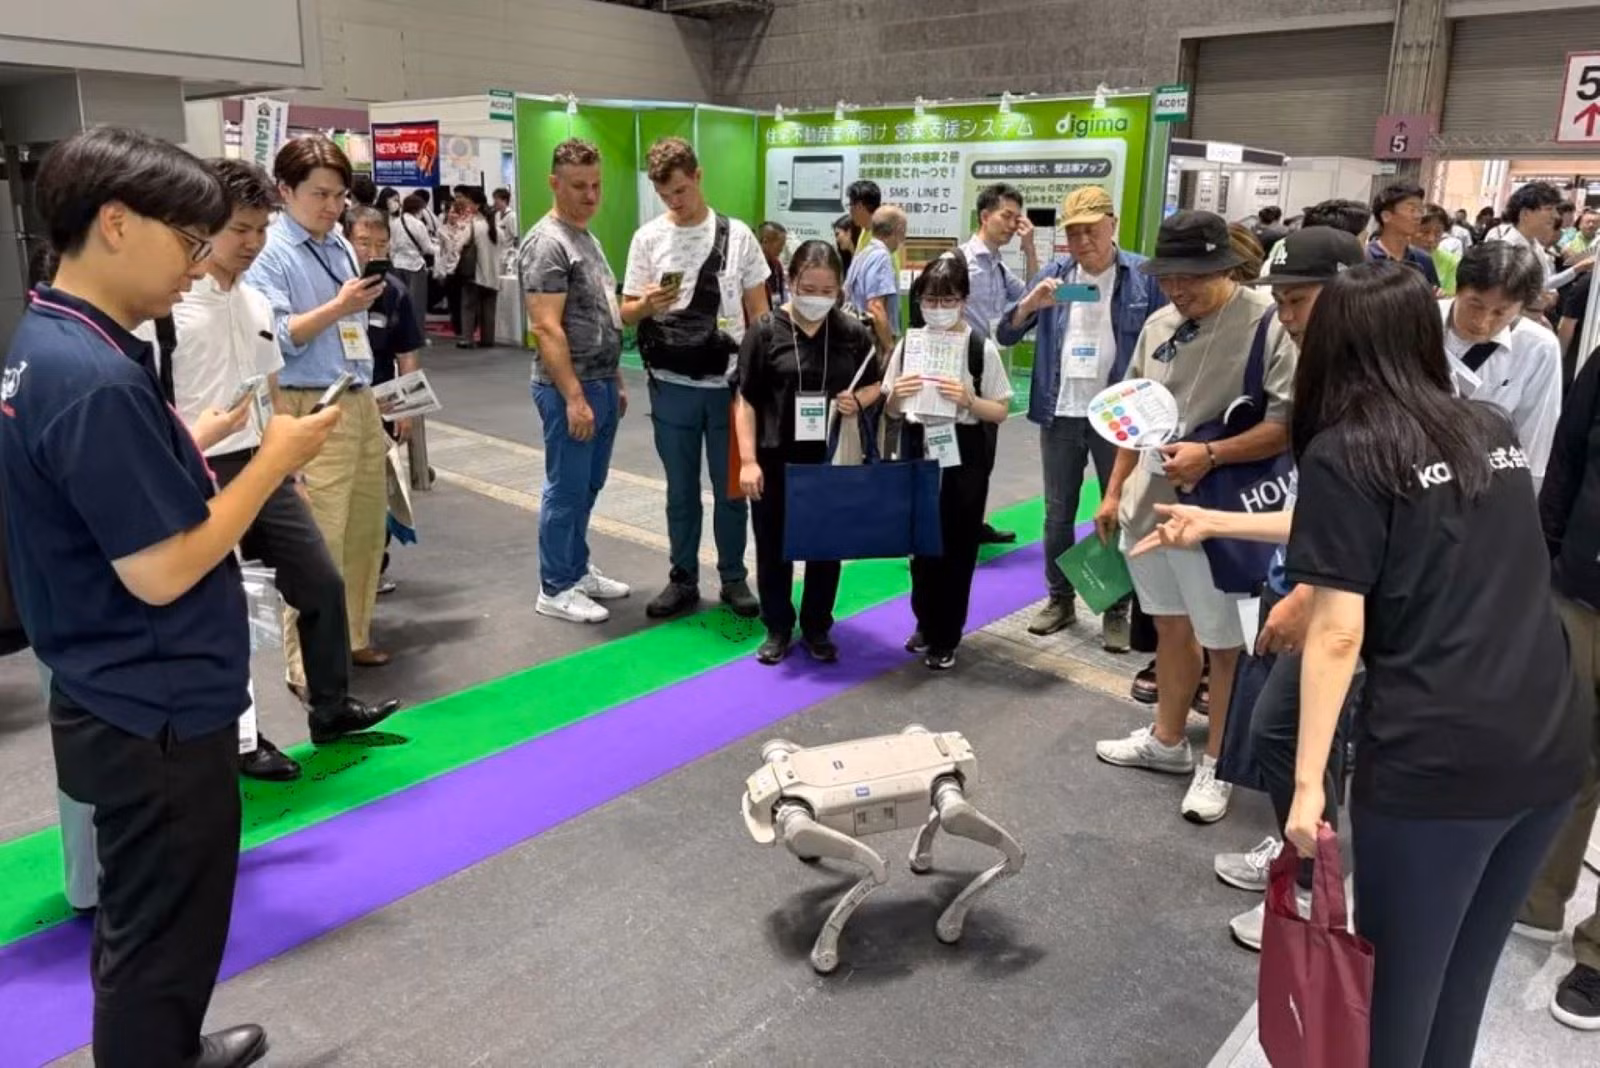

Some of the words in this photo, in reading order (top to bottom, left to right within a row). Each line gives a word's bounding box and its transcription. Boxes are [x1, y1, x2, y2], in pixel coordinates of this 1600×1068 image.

[1576, 65, 1600, 101] 5
[1055, 111, 1127, 138] digima
[1391, 135, 1406, 153] 5
